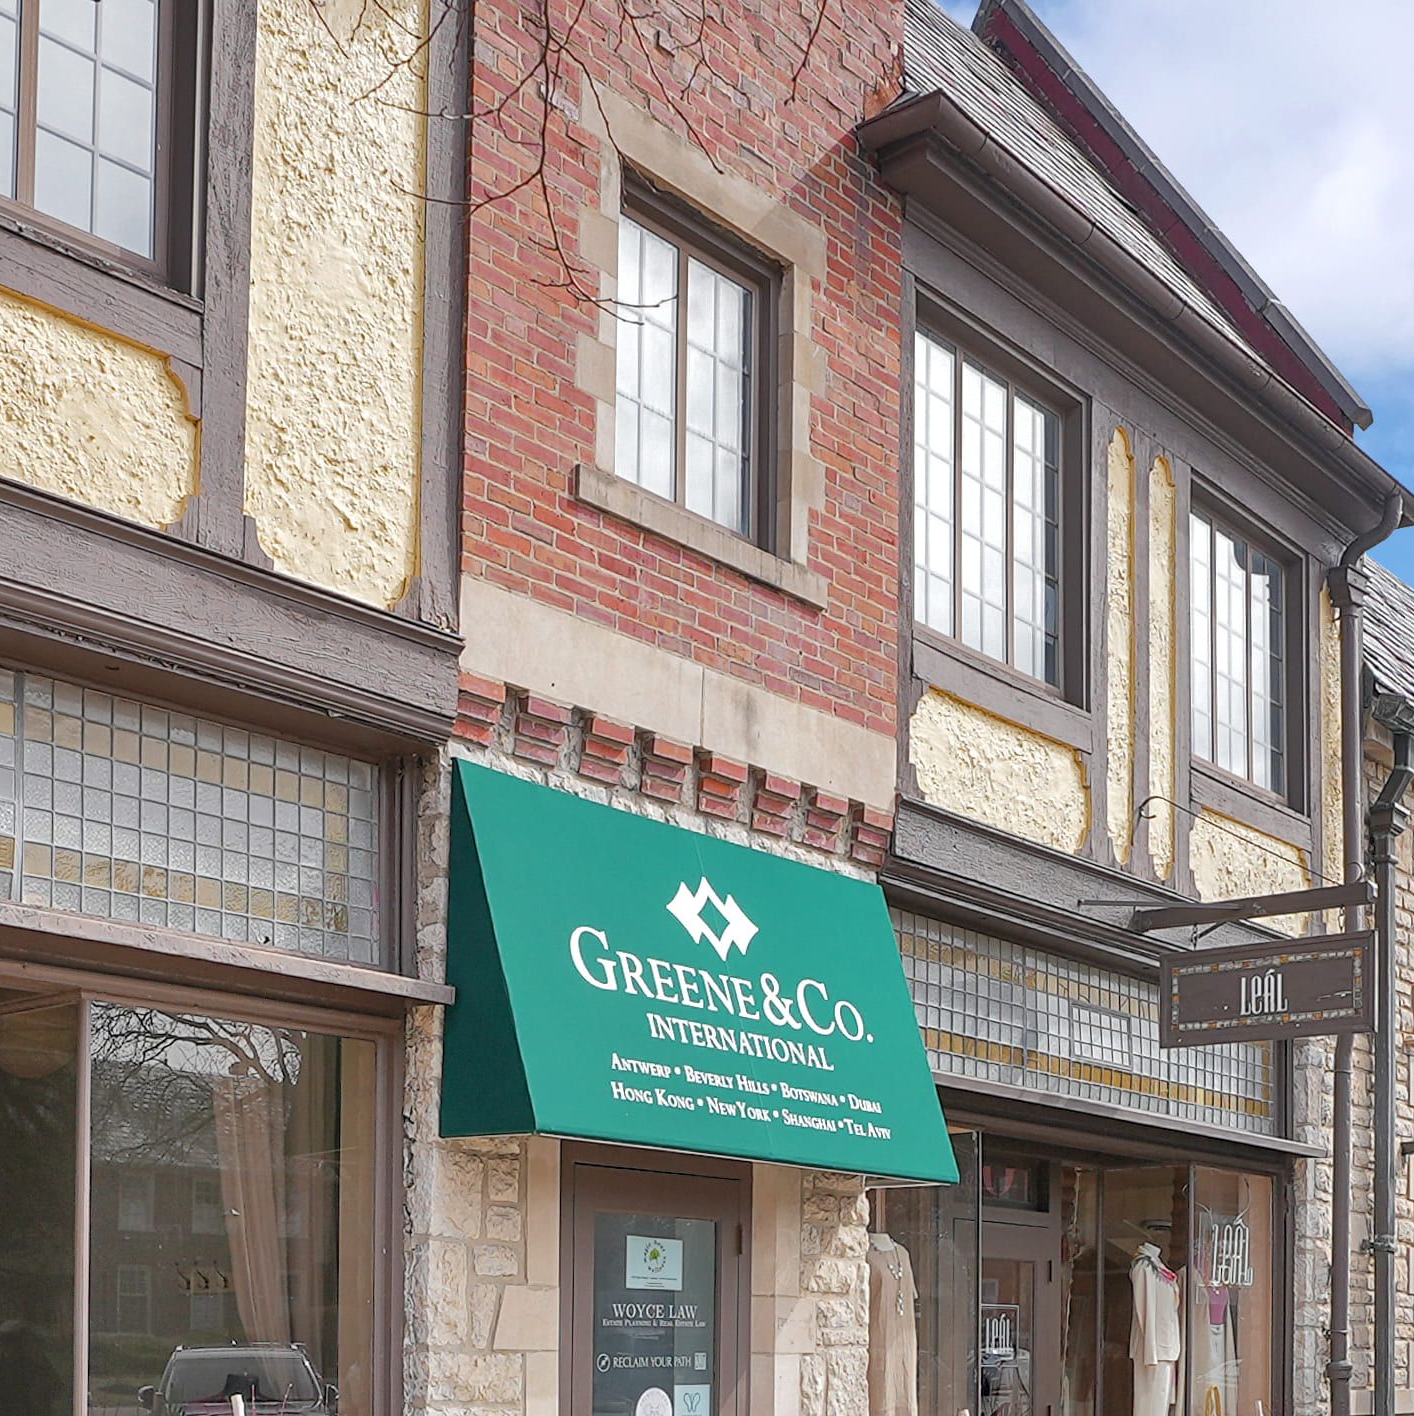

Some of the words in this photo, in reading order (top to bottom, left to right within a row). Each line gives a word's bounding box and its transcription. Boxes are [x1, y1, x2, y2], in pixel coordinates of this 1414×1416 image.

[646, 1013, 834, 1071] INTERNATIONAL
[611, 1052, 672, 1079] ANTWERP
[683, 1065, 734, 1089] BEVERLY
[735, 1074, 770, 1096] HILLS
[779, 1082, 839, 1107] BOTSWANA
[847, 1093, 882, 1114] DUBAI
[611, 1081, 654, 1104] HONG
[654, 1088, 695, 1111] KONG
[781, 1109, 837, 1132] SHANGHAI
[844, 1118, 867, 1136] TEL
[867, 1122, 891, 1140] AVIV
[612, 1303, 664, 1319] WOYCE
[669, 1304, 698, 1320] LAW
[613, 1356, 648, 1368] RECLAIM
[650, 1356, 673, 1368] YOUR
[674, 1356, 692, 1368] PATH
